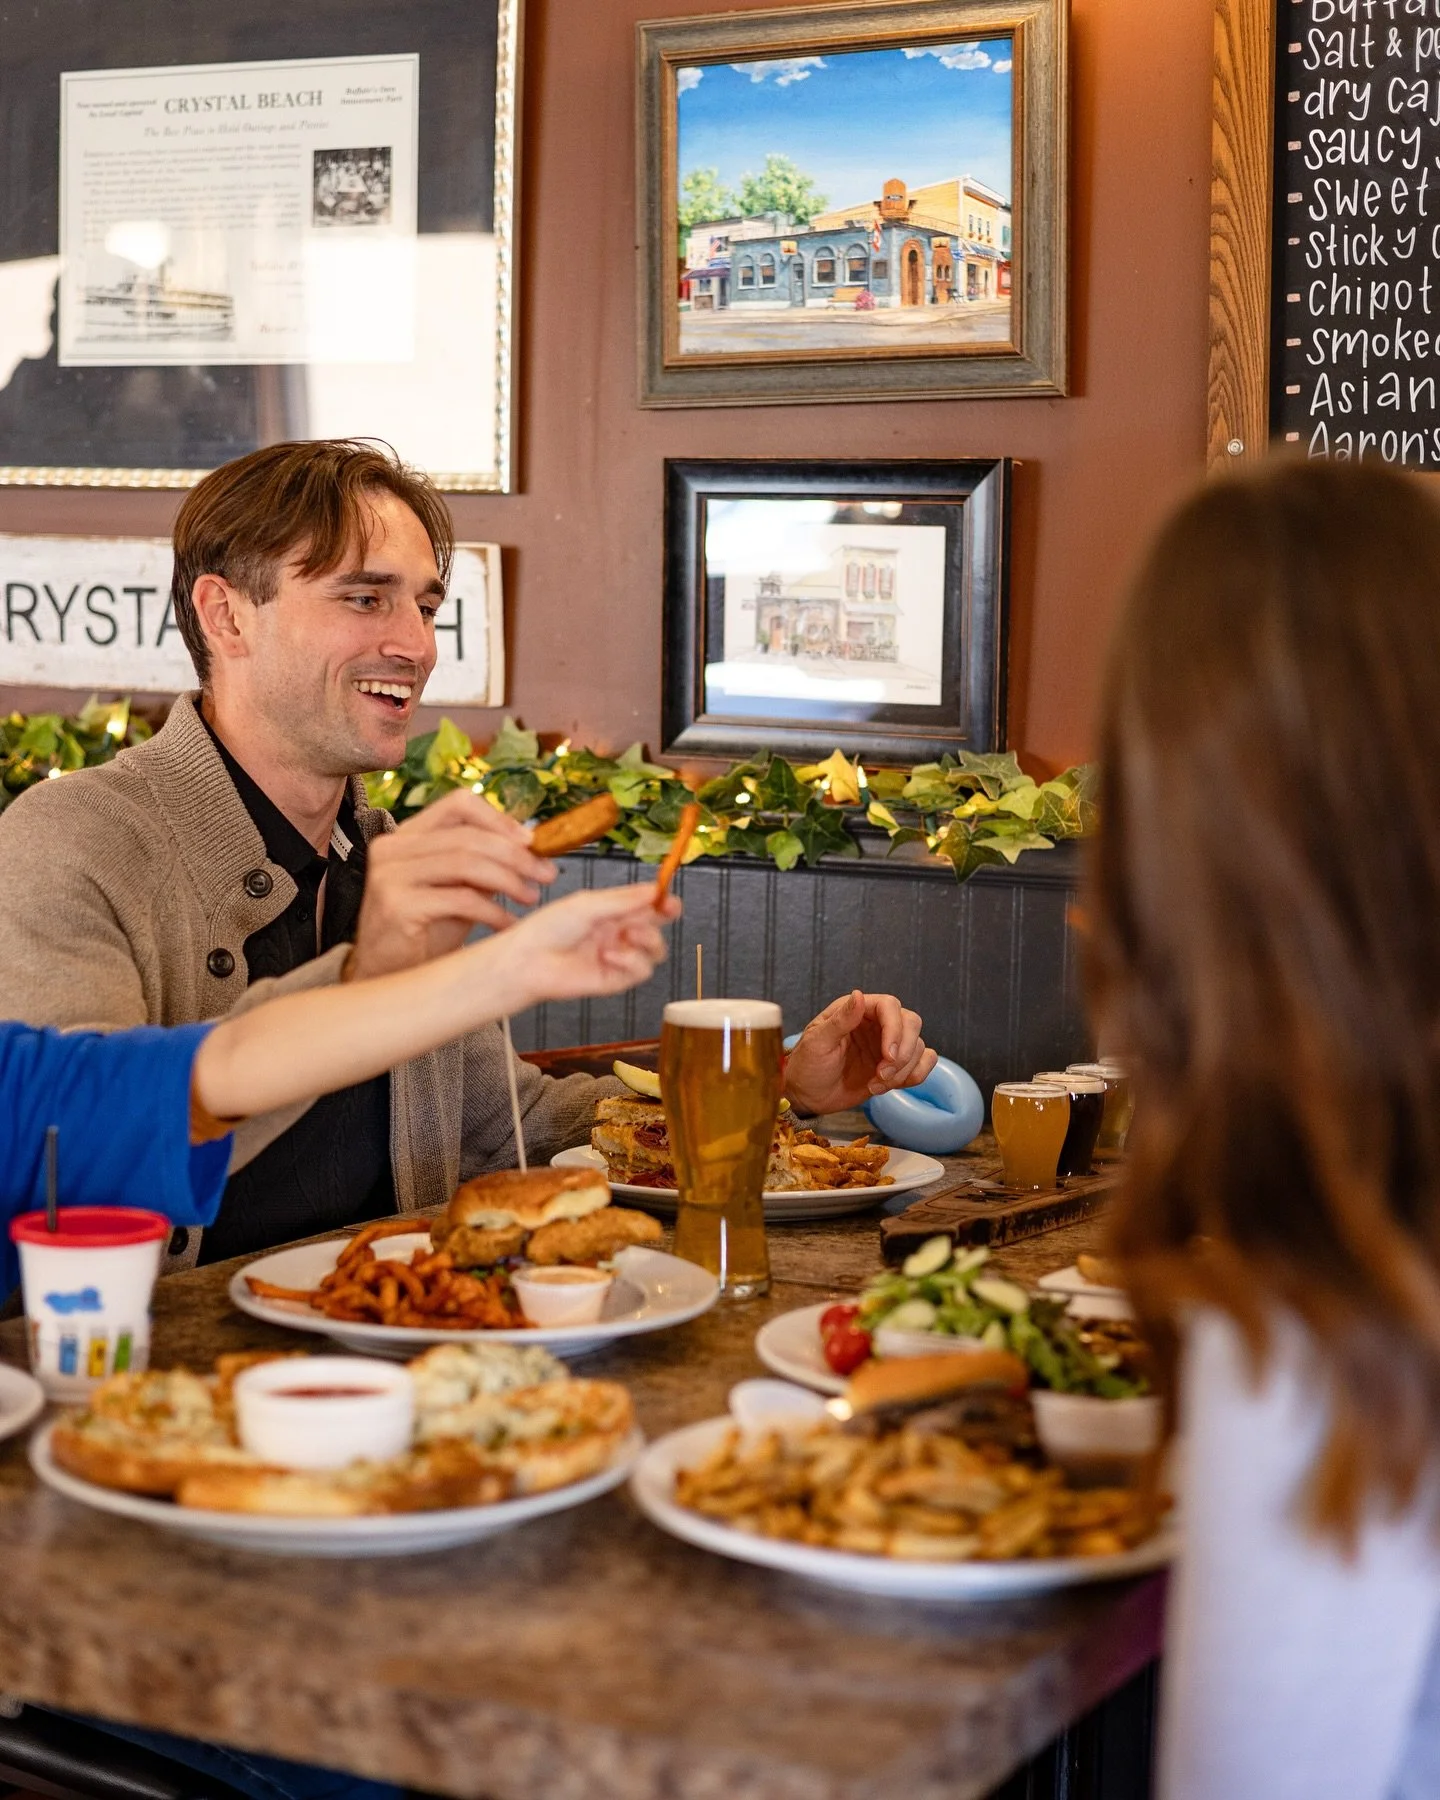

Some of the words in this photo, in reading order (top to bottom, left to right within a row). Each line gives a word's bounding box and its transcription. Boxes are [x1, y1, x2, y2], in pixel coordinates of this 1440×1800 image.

[1387, 27, 1402, 58] &
[164, 94, 252, 114] CRYSTAL
[257, 90, 323, 110] BEACH
[1304, 78, 1371, 121] dry
[1304, 125, 1421, 170] saucy
[1309, 167, 1429, 221] sweet
[1305, 223, 1416, 269] sticky
[1310, 372, 1436, 416] Asian
